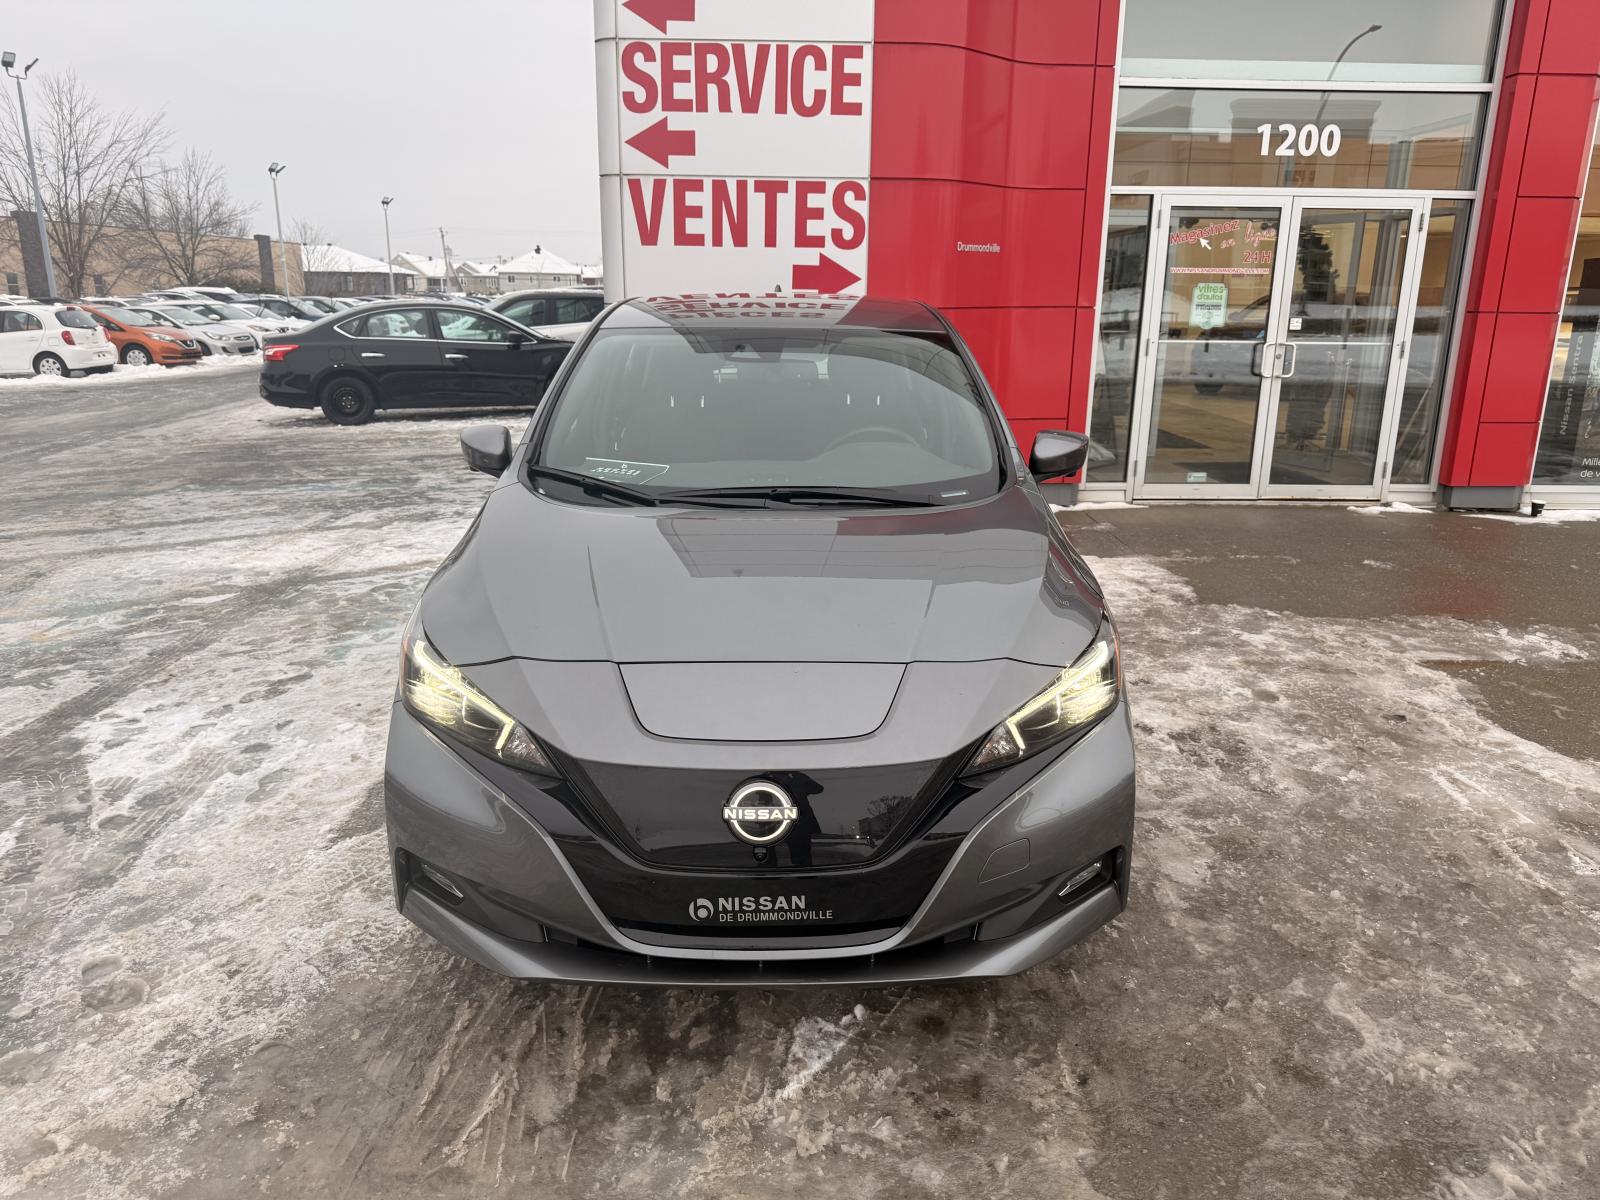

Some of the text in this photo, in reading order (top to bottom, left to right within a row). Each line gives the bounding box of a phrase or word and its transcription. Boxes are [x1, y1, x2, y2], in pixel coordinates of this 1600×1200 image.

[621, 41, 864, 117] SERVICE
[1257, 123, 1341, 157] 1200
[627, 178, 867, 250] VENTES
[1170, 219, 1240, 245] Magasinez
[1198, 283, 1224, 293] vitres
[1560, 335, 1584, 435] Nissan Sentra
[1580, 469, 1594, 478] de
[723, 807, 798, 820] NISSAN
[718, 895, 806, 911] NISSAN
[719, 910, 833, 922] DE DRUMMONDVILLE
